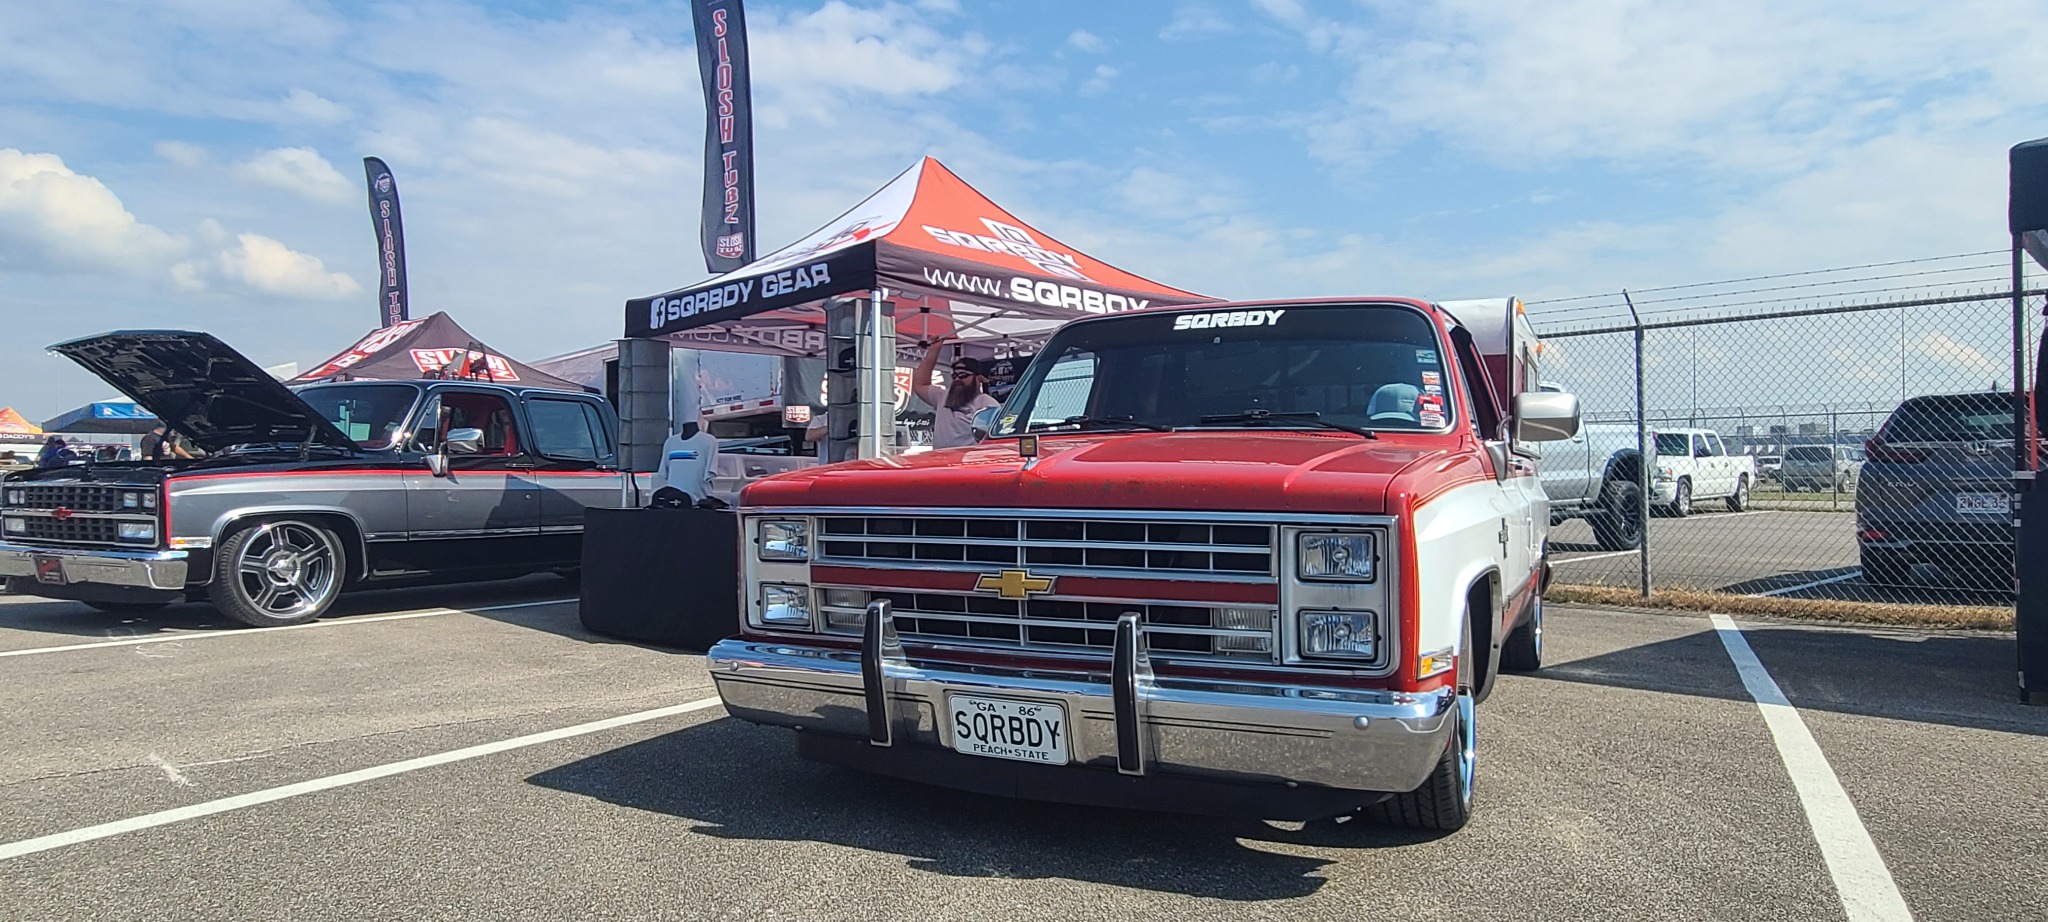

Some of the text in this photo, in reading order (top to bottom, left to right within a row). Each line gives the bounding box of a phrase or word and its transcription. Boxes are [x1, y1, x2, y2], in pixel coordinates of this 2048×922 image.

[712, 8, 734, 144] SLOSH
[722, 150, 739, 224] TUBZ
[380, 200, 397, 287] SLOSH
[388, 291, 401, 326] TUB
[667, 279, 754, 322] SQRBDY
[761, 262, 831, 299] GEAR
[1173, 309, 1286, 330] SQRBDY
[416, 350, 510, 371] SLSH
[976, 701, 1036, 717] GA 86
[955, 710, 1061, 750] SQRBDY
